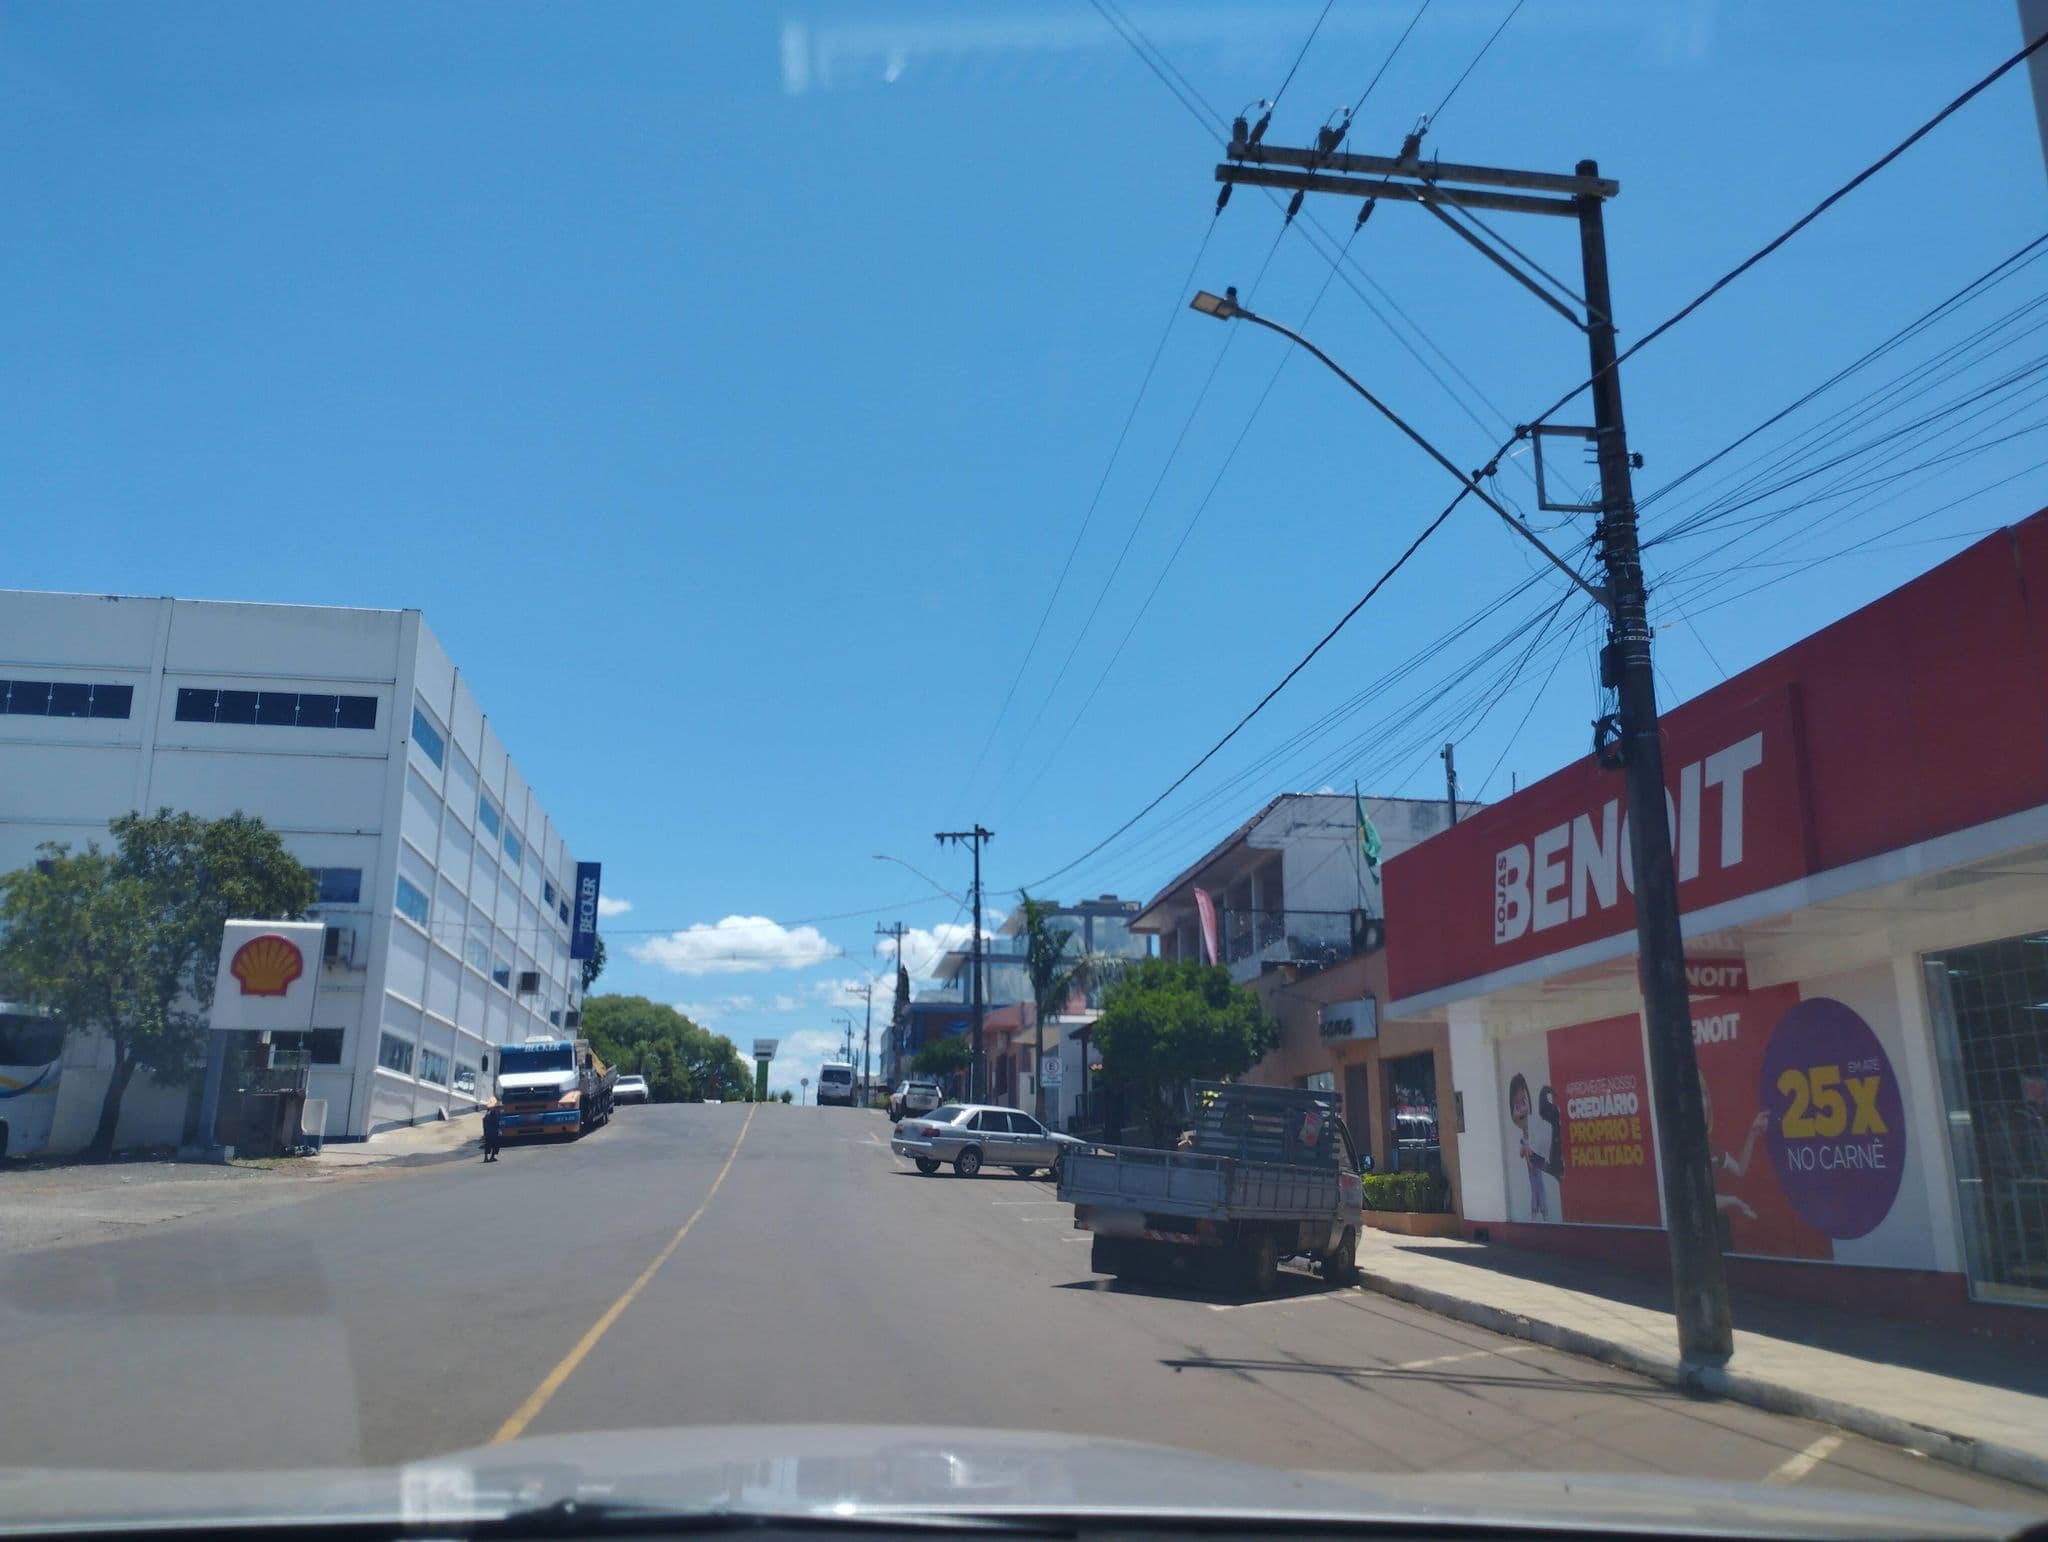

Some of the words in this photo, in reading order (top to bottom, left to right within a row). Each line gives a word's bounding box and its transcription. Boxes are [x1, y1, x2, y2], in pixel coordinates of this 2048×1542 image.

[579, 877, 596, 934] BECKER
[1497, 856, 1507, 938] LOJAS
[1685, 966, 1742, 987] NOIT
[1691, 1013, 1740, 1045] NOIT
[1567, 1089, 1638, 1119] CREDIÁRIO
[1632, 1117, 1641, 1140] E
[1570, 1144, 1645, 1168] FACILITADO
[1787, 1147, 1816, 1171] NO
[1819, 1137, 1887, 1169] CARNÊ
